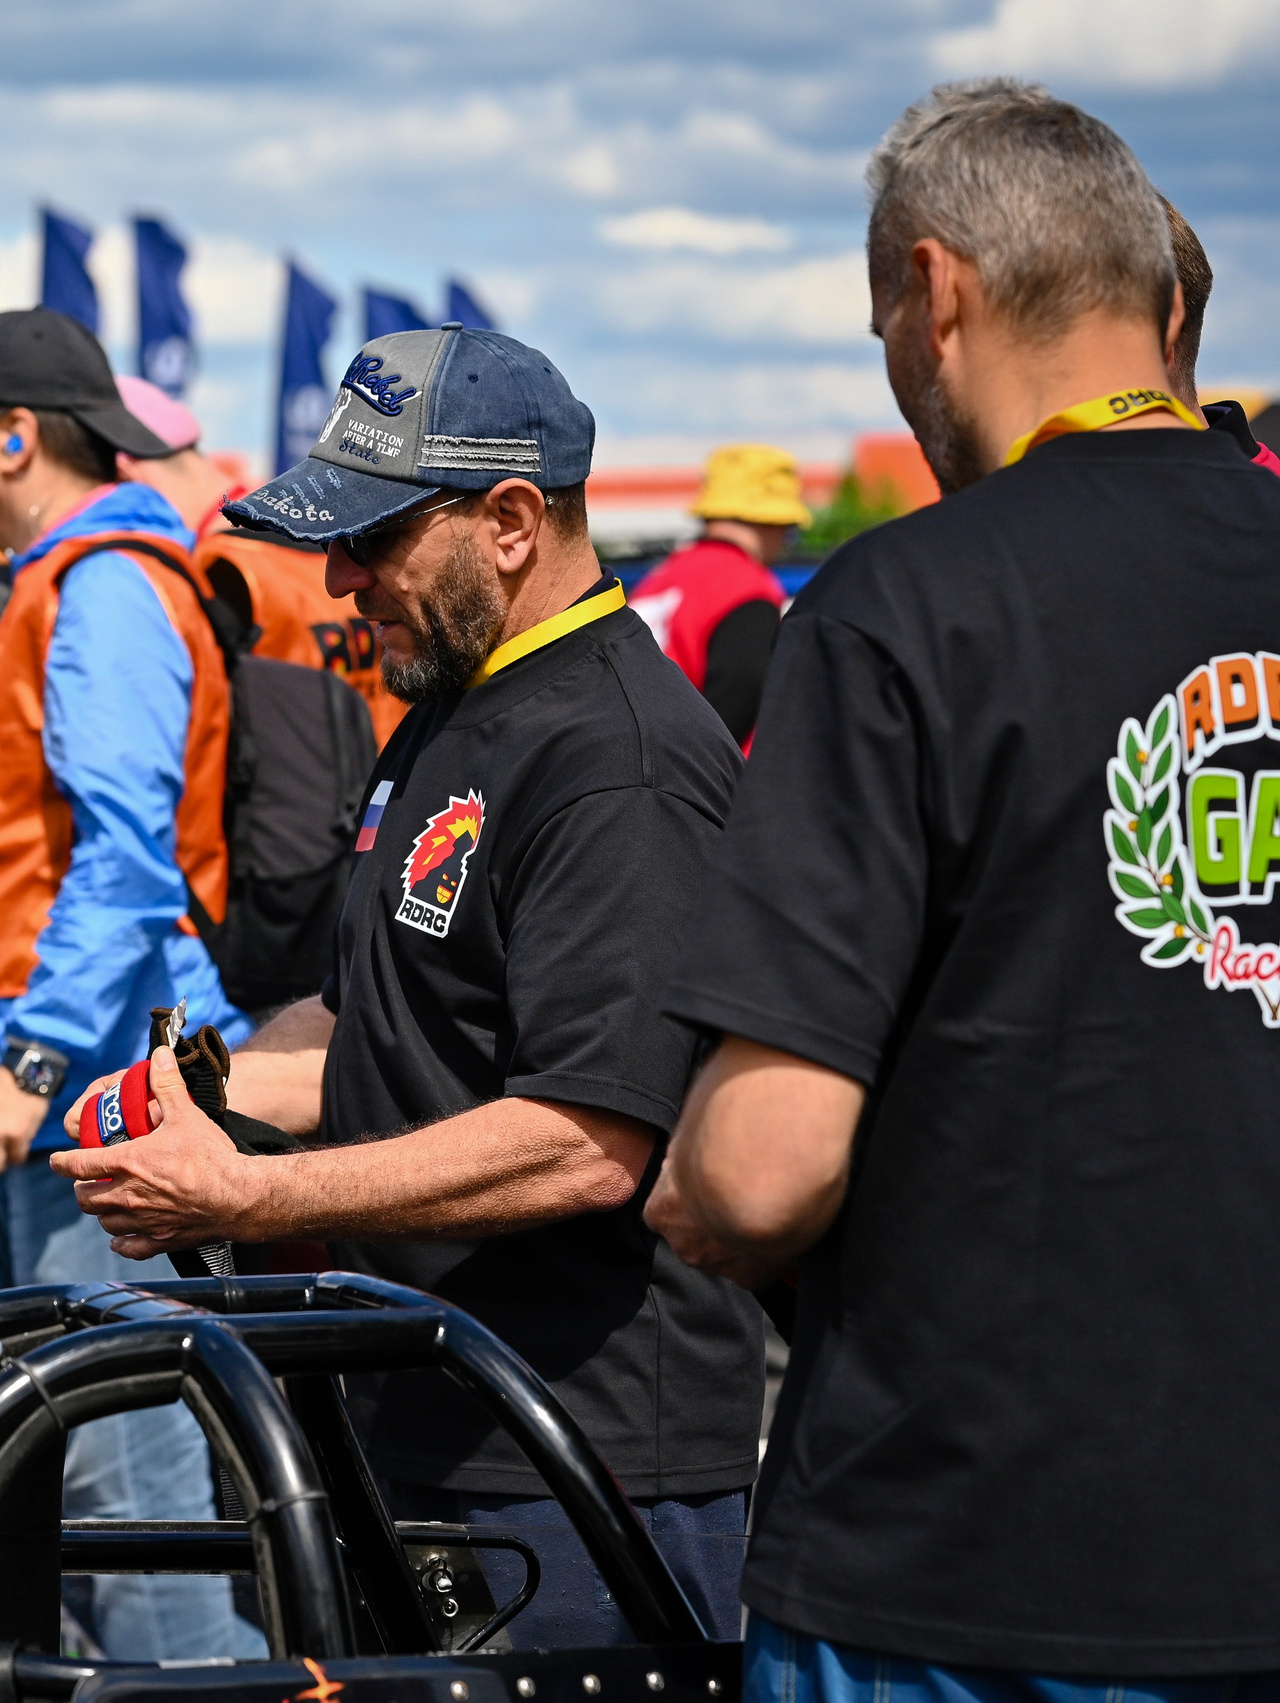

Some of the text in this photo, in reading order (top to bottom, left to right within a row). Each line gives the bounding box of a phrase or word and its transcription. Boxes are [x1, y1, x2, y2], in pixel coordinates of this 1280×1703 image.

[348, 419, 405, 447] VARIATION
[399, 898, 447, 934] RDRC
[1210, 925, 1280, 981] Rac
